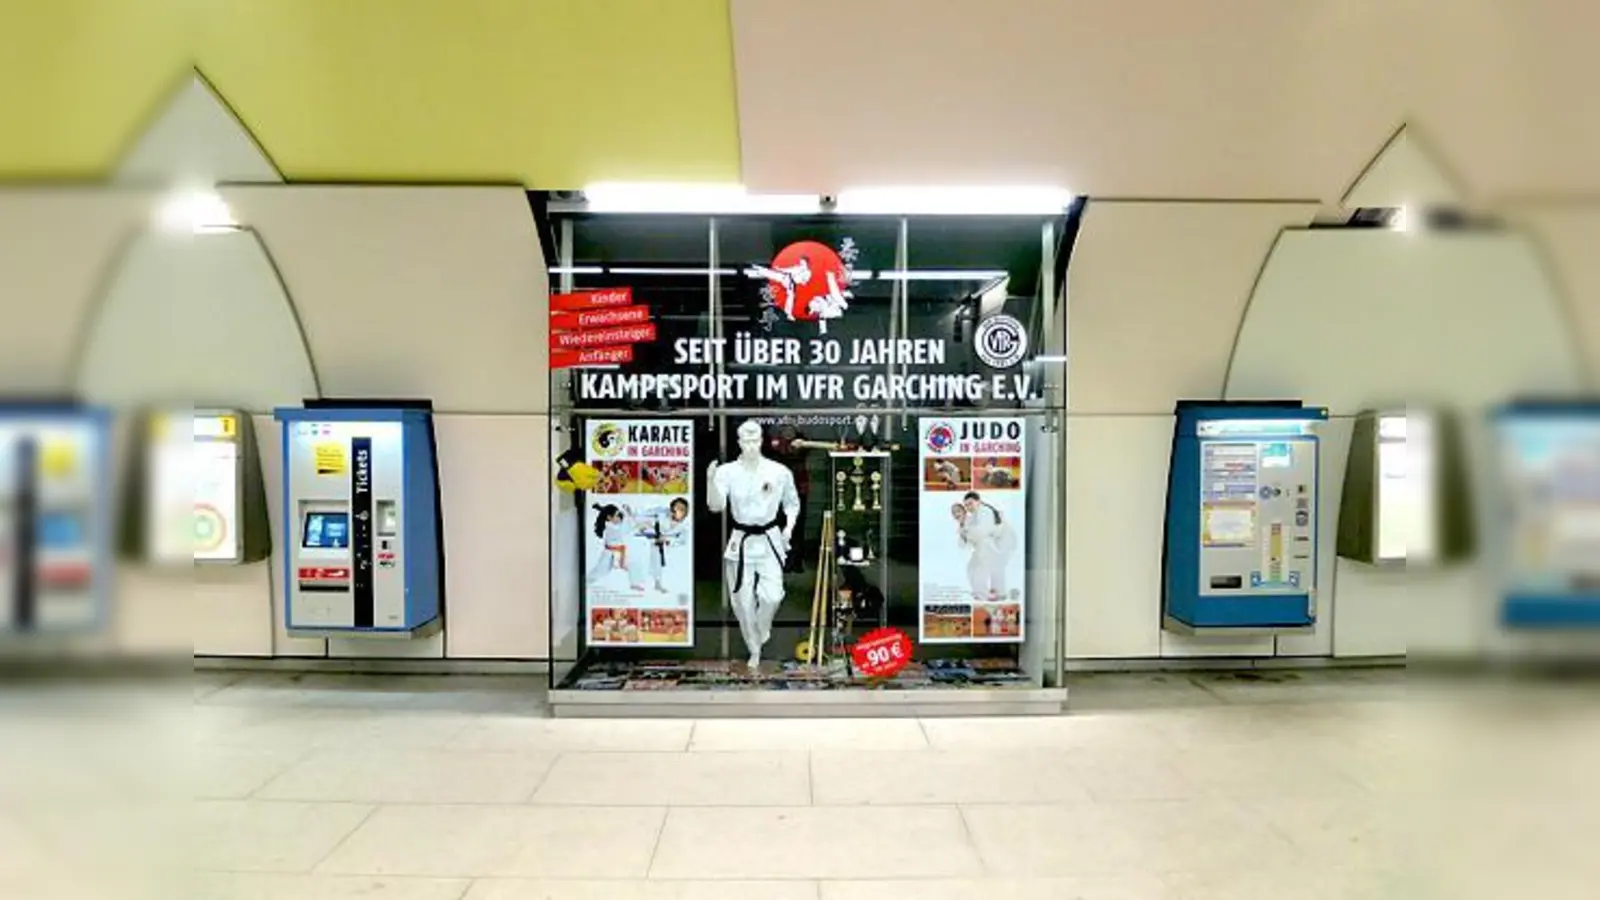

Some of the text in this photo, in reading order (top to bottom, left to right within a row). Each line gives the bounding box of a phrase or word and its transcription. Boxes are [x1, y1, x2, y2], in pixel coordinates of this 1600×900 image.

[591, 290, 627, 304] Kinder
[578, 310, 643, 325] Erwachsene
[559, 328, 650, 345] Wiedereinsteiger
[674, 331, 946, 364] SEIT ÜBER 30 JAHREN
[580, 373, 1038, 400] KAMPFSPORT IM VFR GARCHING E.V.
[628, 425, 690, 443] KARATE
[960, 421, 1020, 440] JUDO
[628, 446, 690, 457] IN GARCHING
[960, 442, 1021, 453] IN GARCHING
[356, 449, 369, 493] Tickets
[867, 646, 890, 666] 90
[890, 641, 905, 658] €
